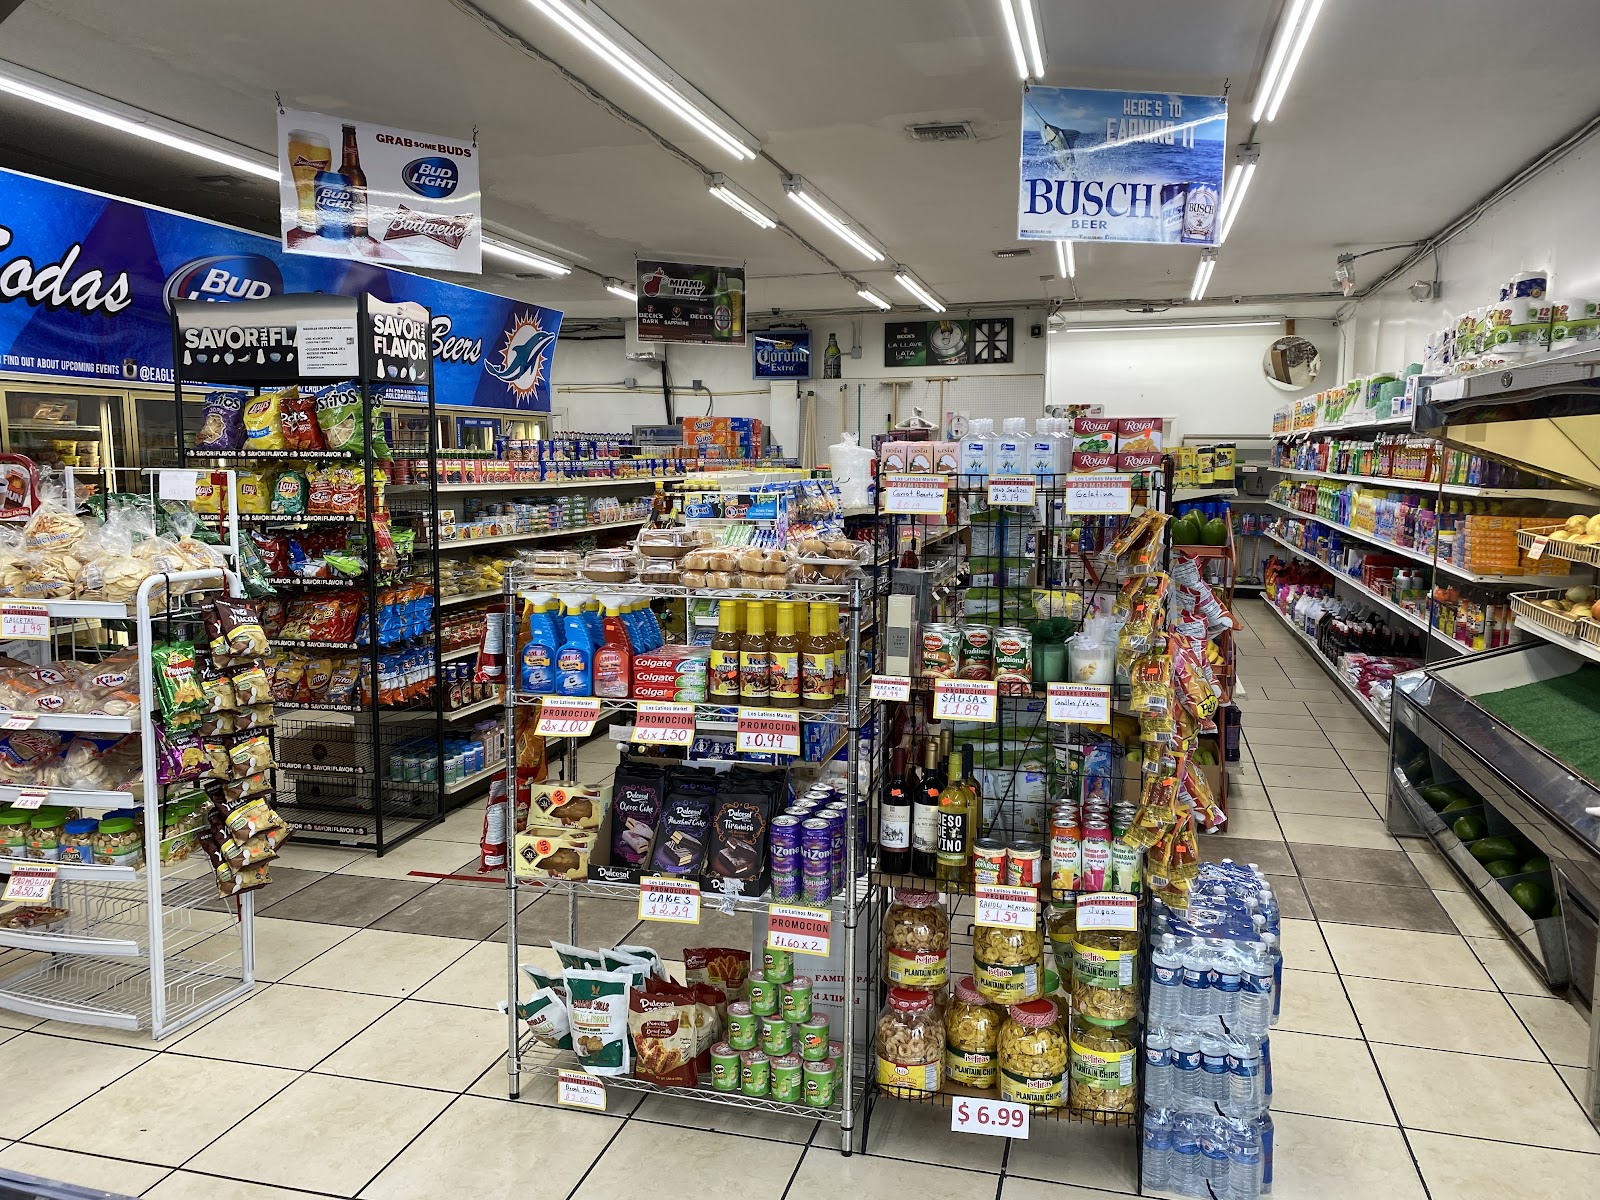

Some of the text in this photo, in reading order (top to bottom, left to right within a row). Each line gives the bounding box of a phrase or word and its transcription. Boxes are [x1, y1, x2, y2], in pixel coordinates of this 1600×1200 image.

[1123, 99, 1182, 118] HERE'S TO
[1106, 118, 1195, 149] EARNING IT
[375, 133, 472, 158] GRAB SOME BUDS
[418, 164, 452, 178] BUD
[411, 174, 456, 190] LIGHT
[321, 189, 350, 200] BUD
[1024, 178, 1156, 218] BUSCH
[1189, 202, 1214, 215] BUSCH
[1071, 219, 1108, 230] BEER
[201, 268, 271, 300] BUD
[374, 315, 421, 337] SAVOR
[185, 327, 259, 350] SAVOR
[260, 327, 268, 348] THE
[432, 315, 482, 363] Beers
[374, 340, 426, 361] FLAVOR
[757, 348, 808, 367] Corona
[3, 355, 120, 375] FIND OUT ABOUT UPCOMING EVENTS
[771, 364, 794, 372] Extra
[1081, 420, 1110, 432] Royal
[1125, 420, 1154, 432] Royal
[1081, 454, 1110, 466] Royal
[1125, 454, 1154, 466] Royal
[1076, 490, 1114, 498] Gelatina
[924, 652, 940, 660] Meat
[996, 656, 1025, 664] Traditional
[635, 658, 672, 668] Colgate
[636, 672, 674, 682] Colgate
[942, 694, 988, 704] SALSAS
[543, 709, 596, 718] PROMOCION
[639, 716, 692, 724] PROMOCION
[740, 722, 796, 732] PROMOCION
[660, 729, 688, 741] 1.50
[626, 790, 648, 802] Dulcesol
[728, 809, 752, 820] Dulcesol
[938, 815, 962, 826] BESO
[938, 826, 947, 838] DE
[938, 840, 962, 852] VINO
[598, 868, 630, 881] Dulcesol
[650, 886, 691, 894] PROMOCION
[648, 894, 691, 904] CAKES
[772, 918, 828, 933] PROMOCION
[774, 936, 800, 948] $1.60
[904, 968, 946, 977] PLANTAIN CHIPS
[1074, 963, 1118, 978] PLANTAIN CHIPS
[980, 978, 1024, 990] PLANTAIN CHIPS
[955, 1064, 997, 1076] PLANTAIN CHIP
[1074, 1062, 1118, 1078] PLANTAIN CHIPS
[1016, 1090, 1061, 1102] PLANTAIN CHIPS
[958, 1102, 1024, 1128] $ 6.99
